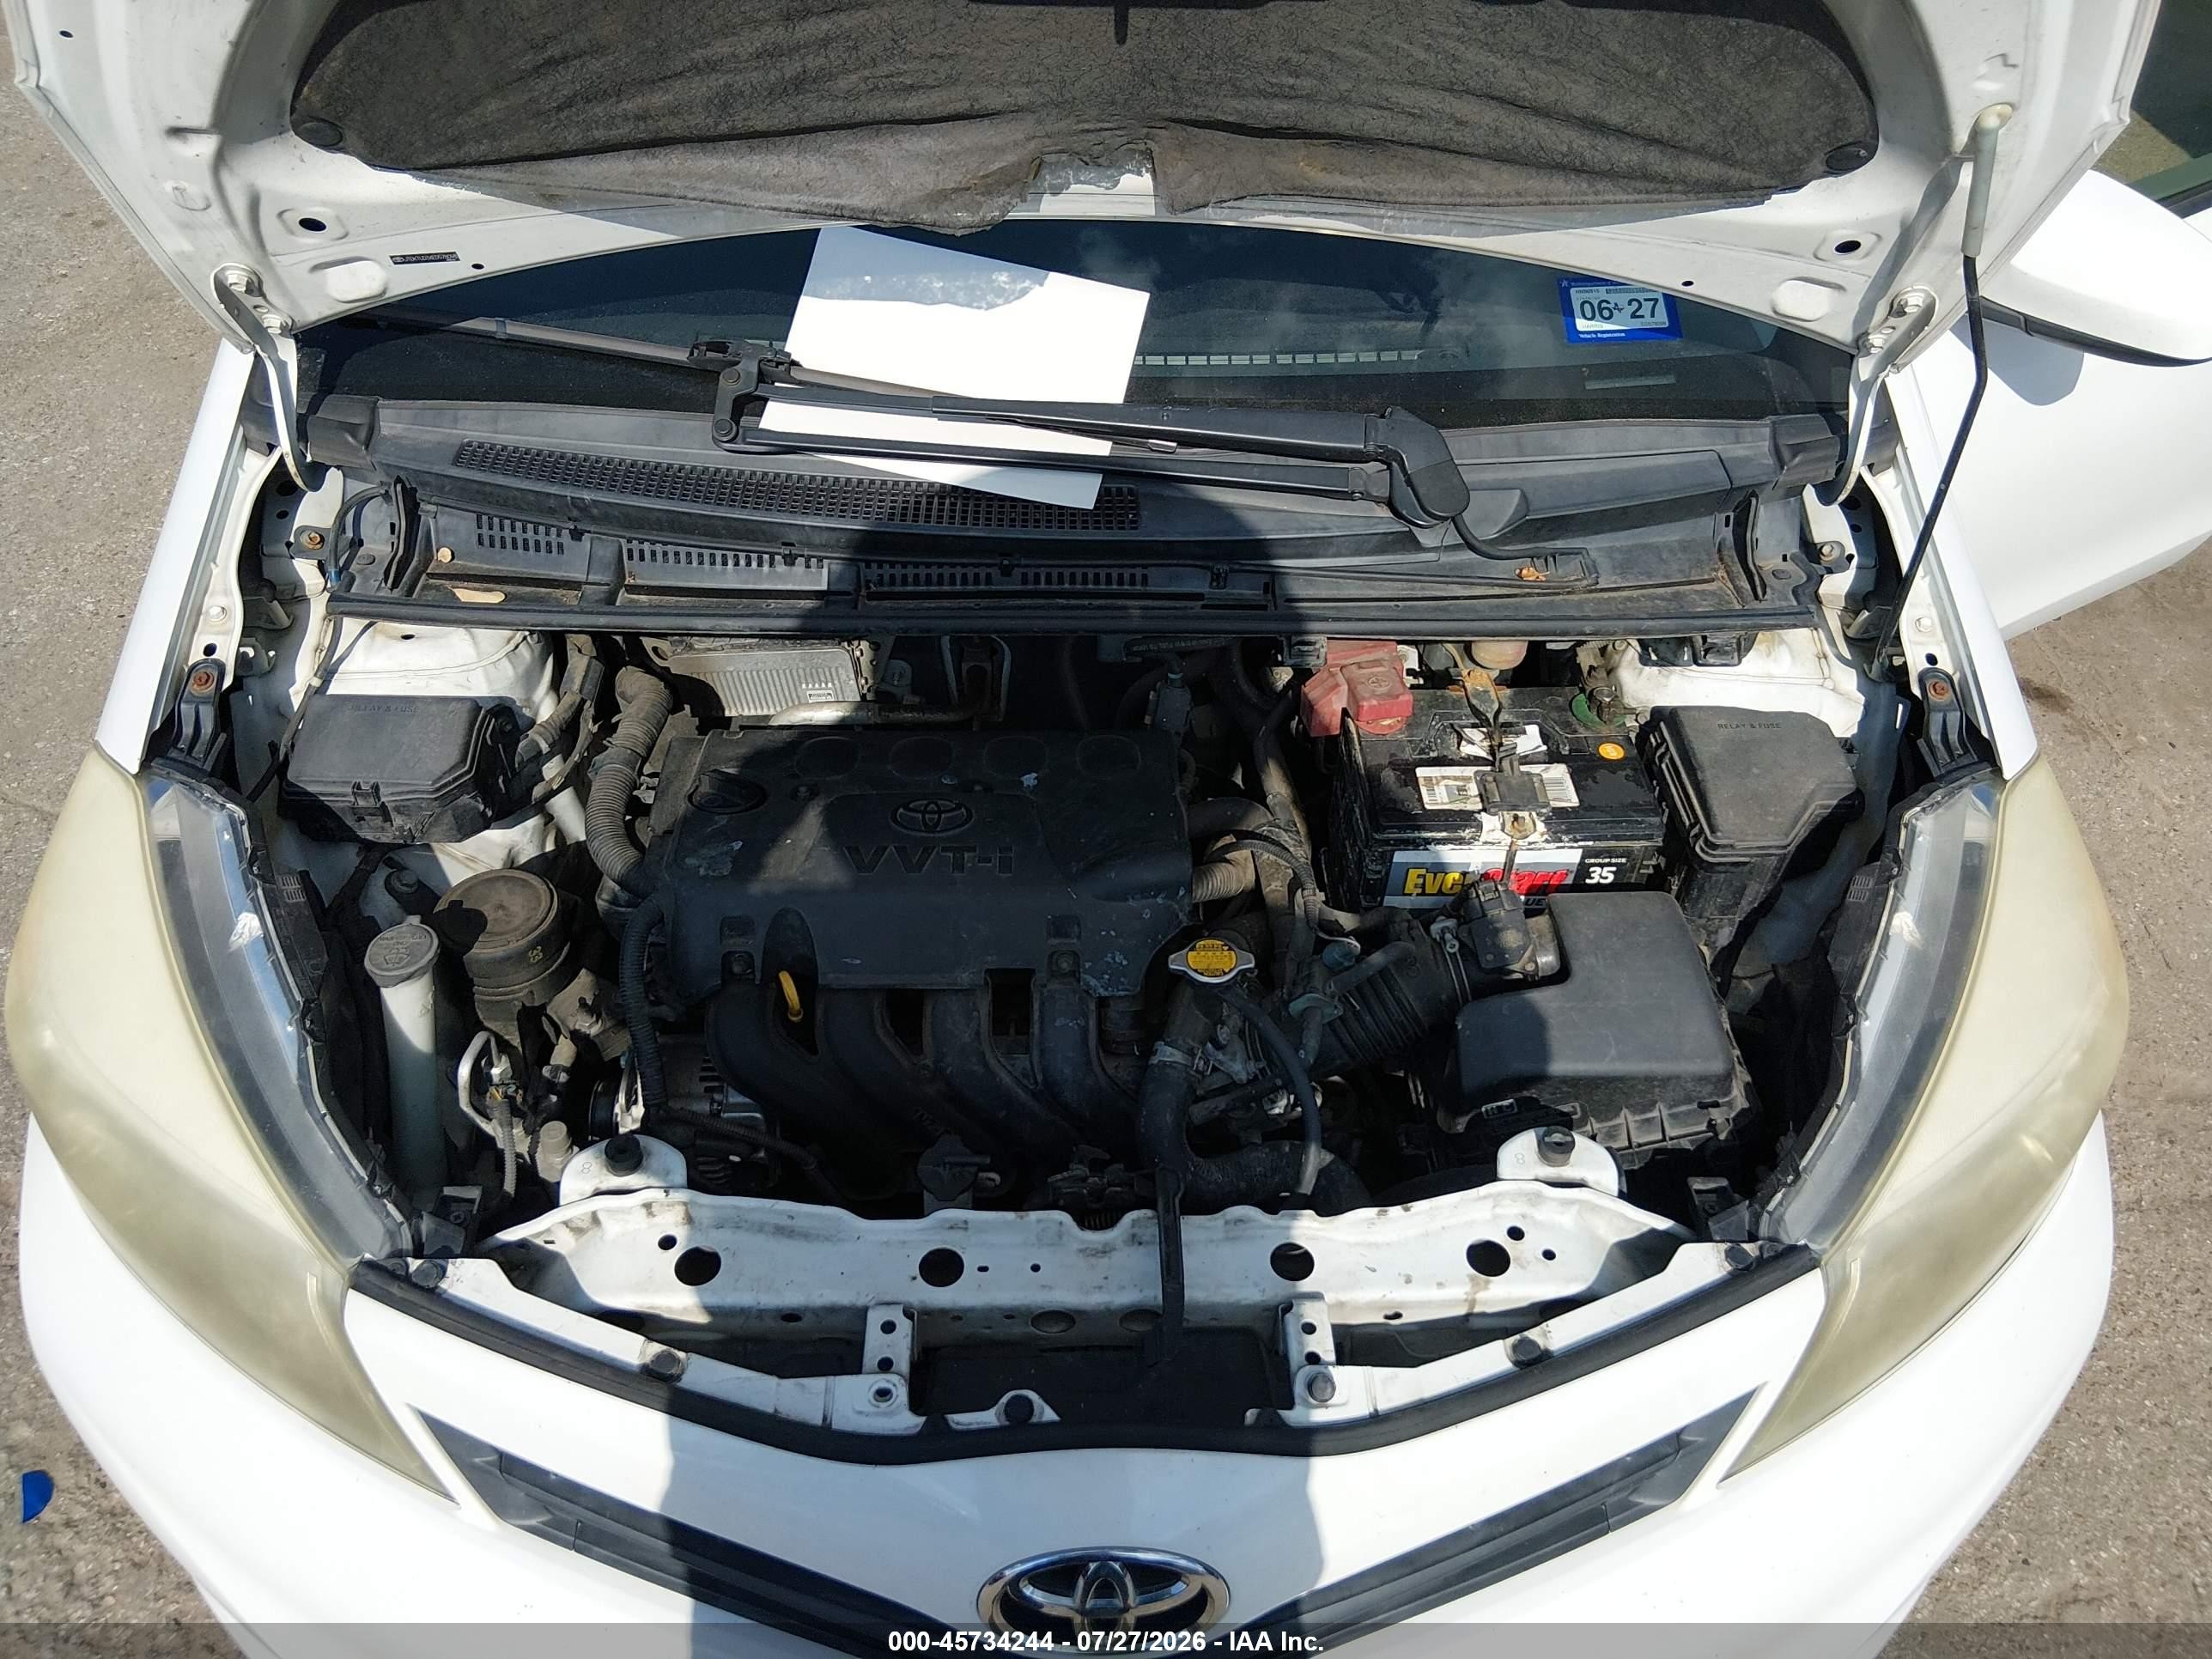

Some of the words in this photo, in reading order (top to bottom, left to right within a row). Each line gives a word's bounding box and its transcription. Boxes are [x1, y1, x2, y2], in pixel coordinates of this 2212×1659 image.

[1579, 299, 1614, 321] 06
[1627, 297, 1659, 319] 27
[843, 845, 1013, 876] VVT-i
[1585, 866, 1617, 884] 35
